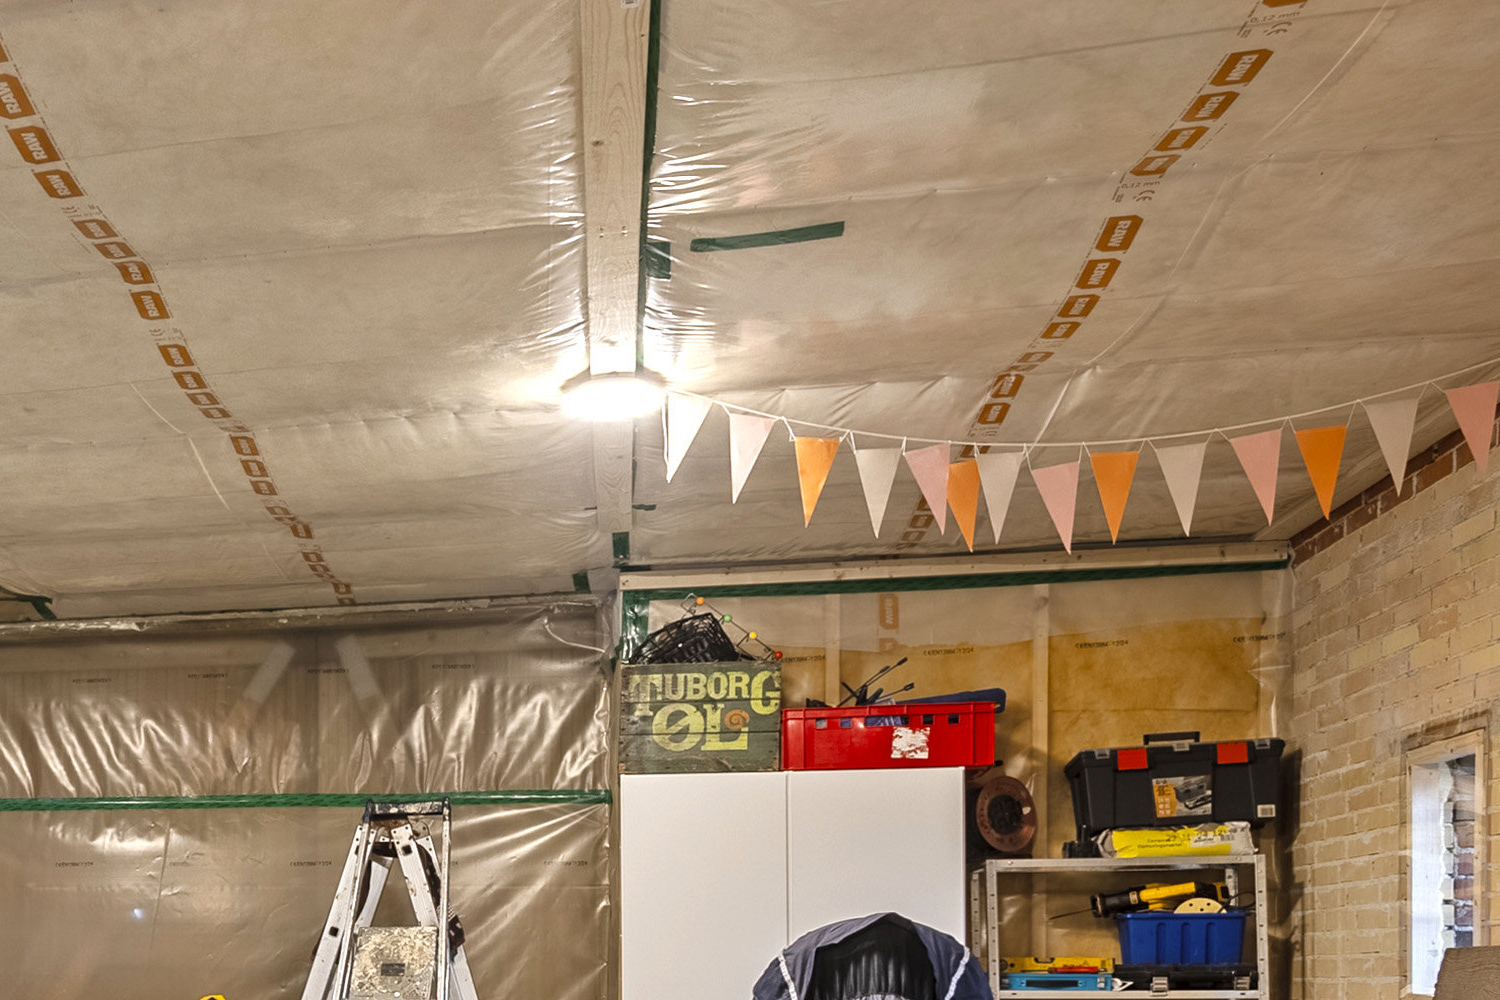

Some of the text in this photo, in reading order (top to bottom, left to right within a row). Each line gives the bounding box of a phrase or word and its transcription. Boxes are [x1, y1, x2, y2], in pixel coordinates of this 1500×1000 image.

[1249, 11, 1300, 24] 0,12 mm
[1225, 54, 1260, 82] RAW
[1195, 94, 1227, 118] RAW
[20, 132, 49, 161] RAW
[46, 174, 72, 197] RAW
[1107, 220, 1132, 247] RAW
[1087, 262, 1111, 285] RAW
[140, 295, 161, 318] RAW
[628, 670, 782, 717] TUBORG
